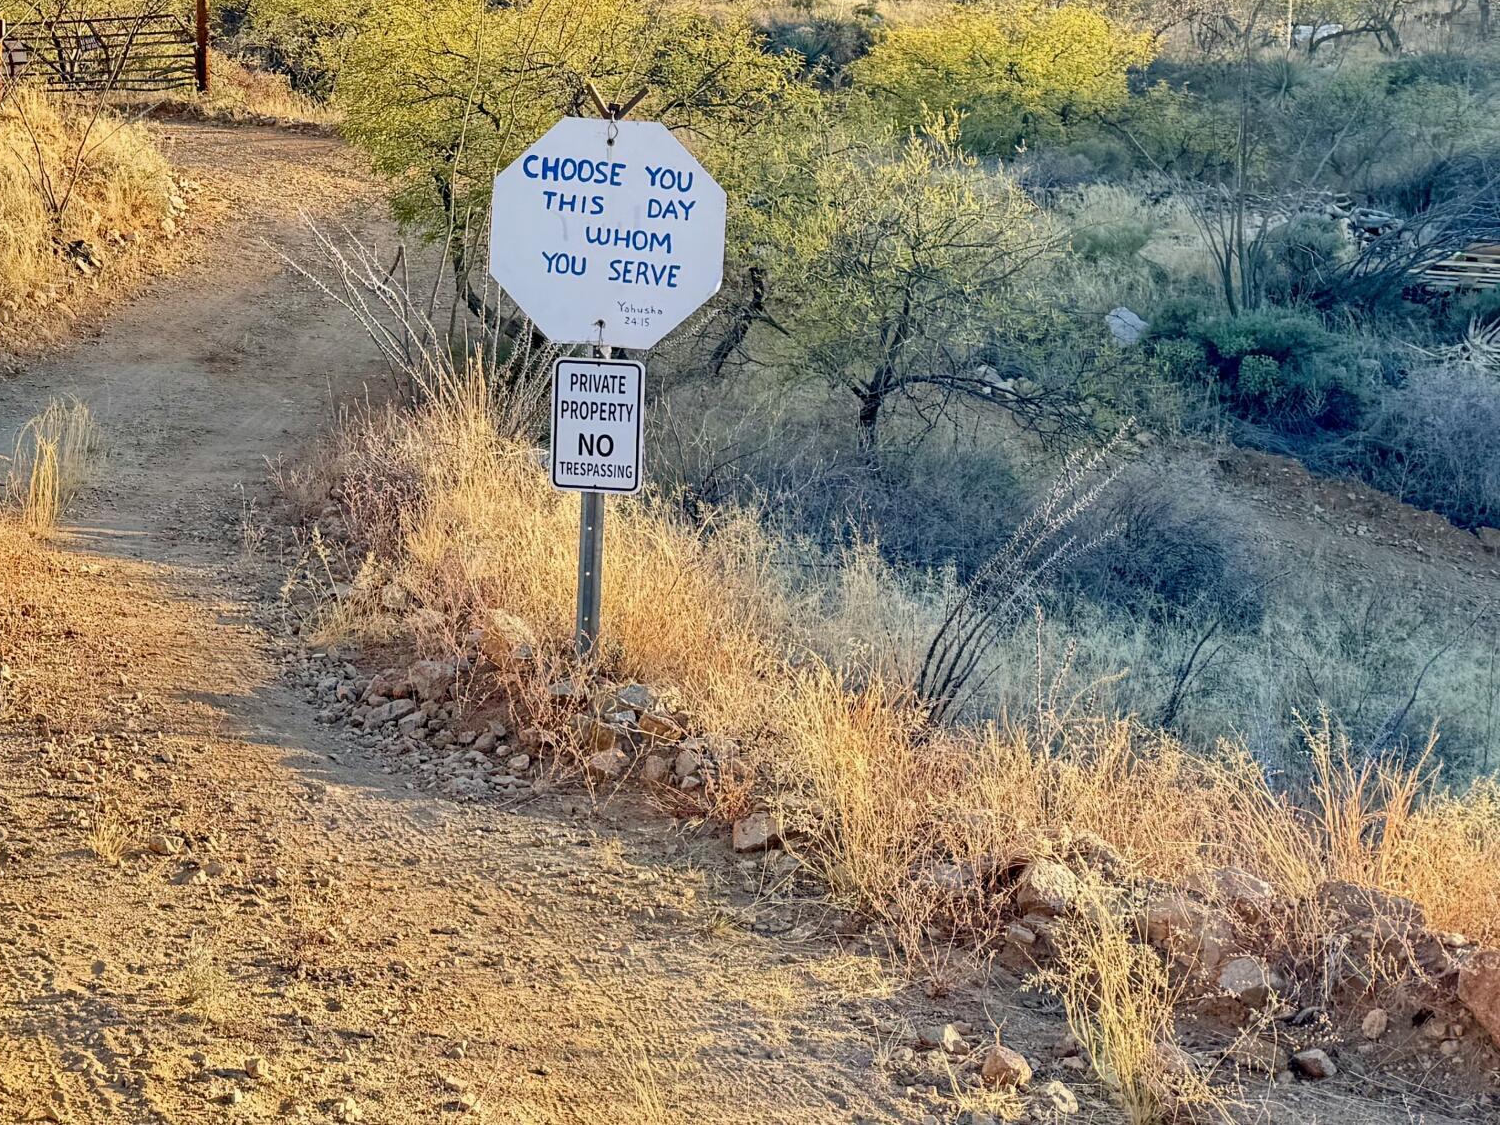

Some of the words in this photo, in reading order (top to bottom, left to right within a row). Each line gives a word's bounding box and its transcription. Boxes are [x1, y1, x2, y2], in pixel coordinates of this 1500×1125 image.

[522, 154, 626, 186] CHOOSE
[644, 165, 694, 192] YOU
[543, 191, 604, 215] THIS
[647, 198, 696, 221] DAY
[585, 226, 672, 254] WHOM
[541, 251, 587, 276] YOU
[608, 259, 681, 288] SERVE
[570, 373, 626, 394] PRIVATE
[561, 400, 634, 422] PROPERTY
[578, 433, 614, 457] NO
[560, 461, 633, 479] TRESPASSING
